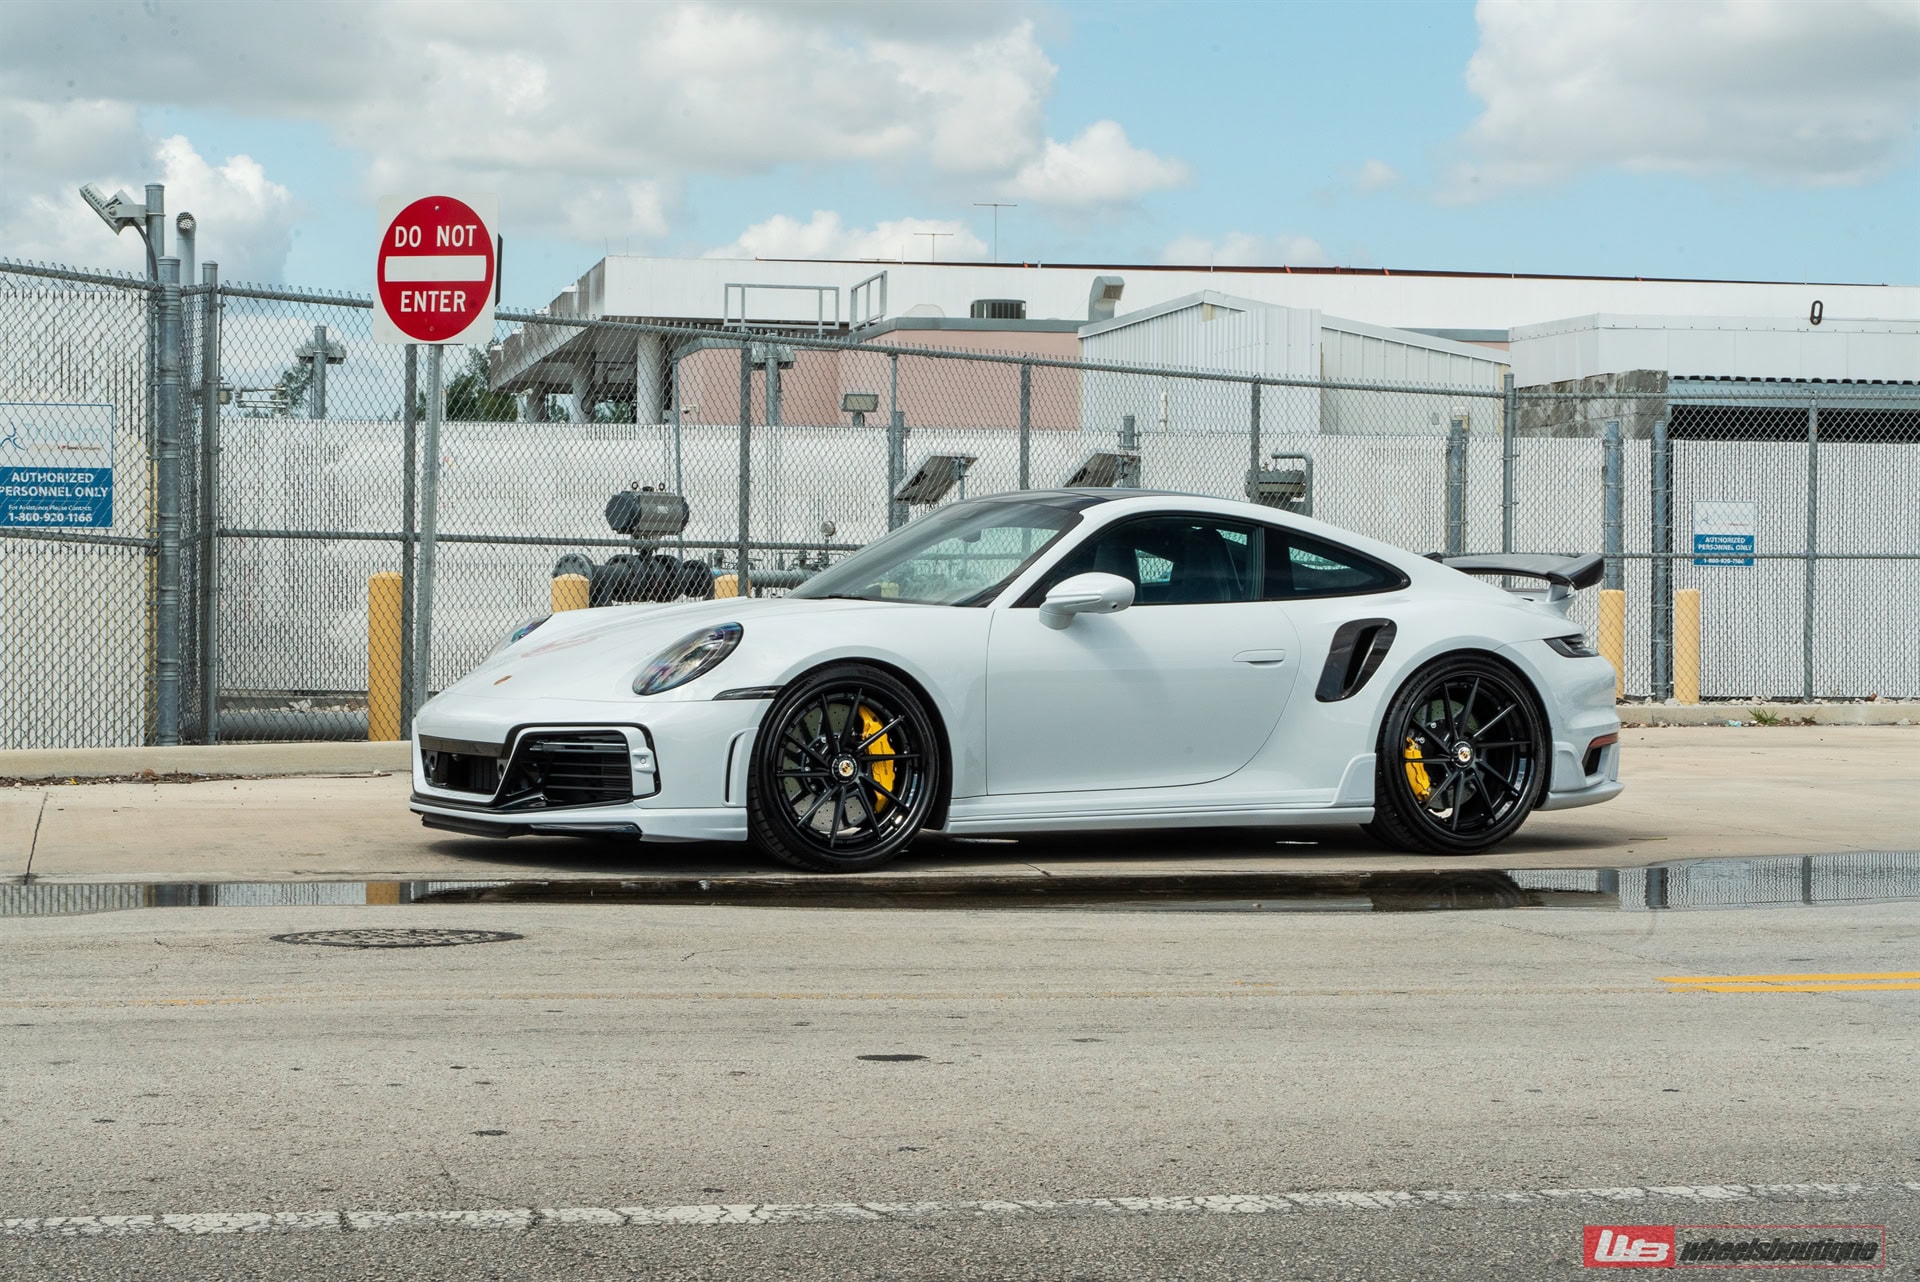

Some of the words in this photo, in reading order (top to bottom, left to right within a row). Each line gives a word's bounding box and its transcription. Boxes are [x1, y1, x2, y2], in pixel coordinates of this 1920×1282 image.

[395, 225, 422, 248] DO
[436, 225, 477, 247] NOT
[400, 290, 466, 313] ENTER
[11, 472, 95, 484] AUTHORIZED
[75, 487, 109, 498] ONLY
[8, 513, 93, 522] 1-800-920-1166
